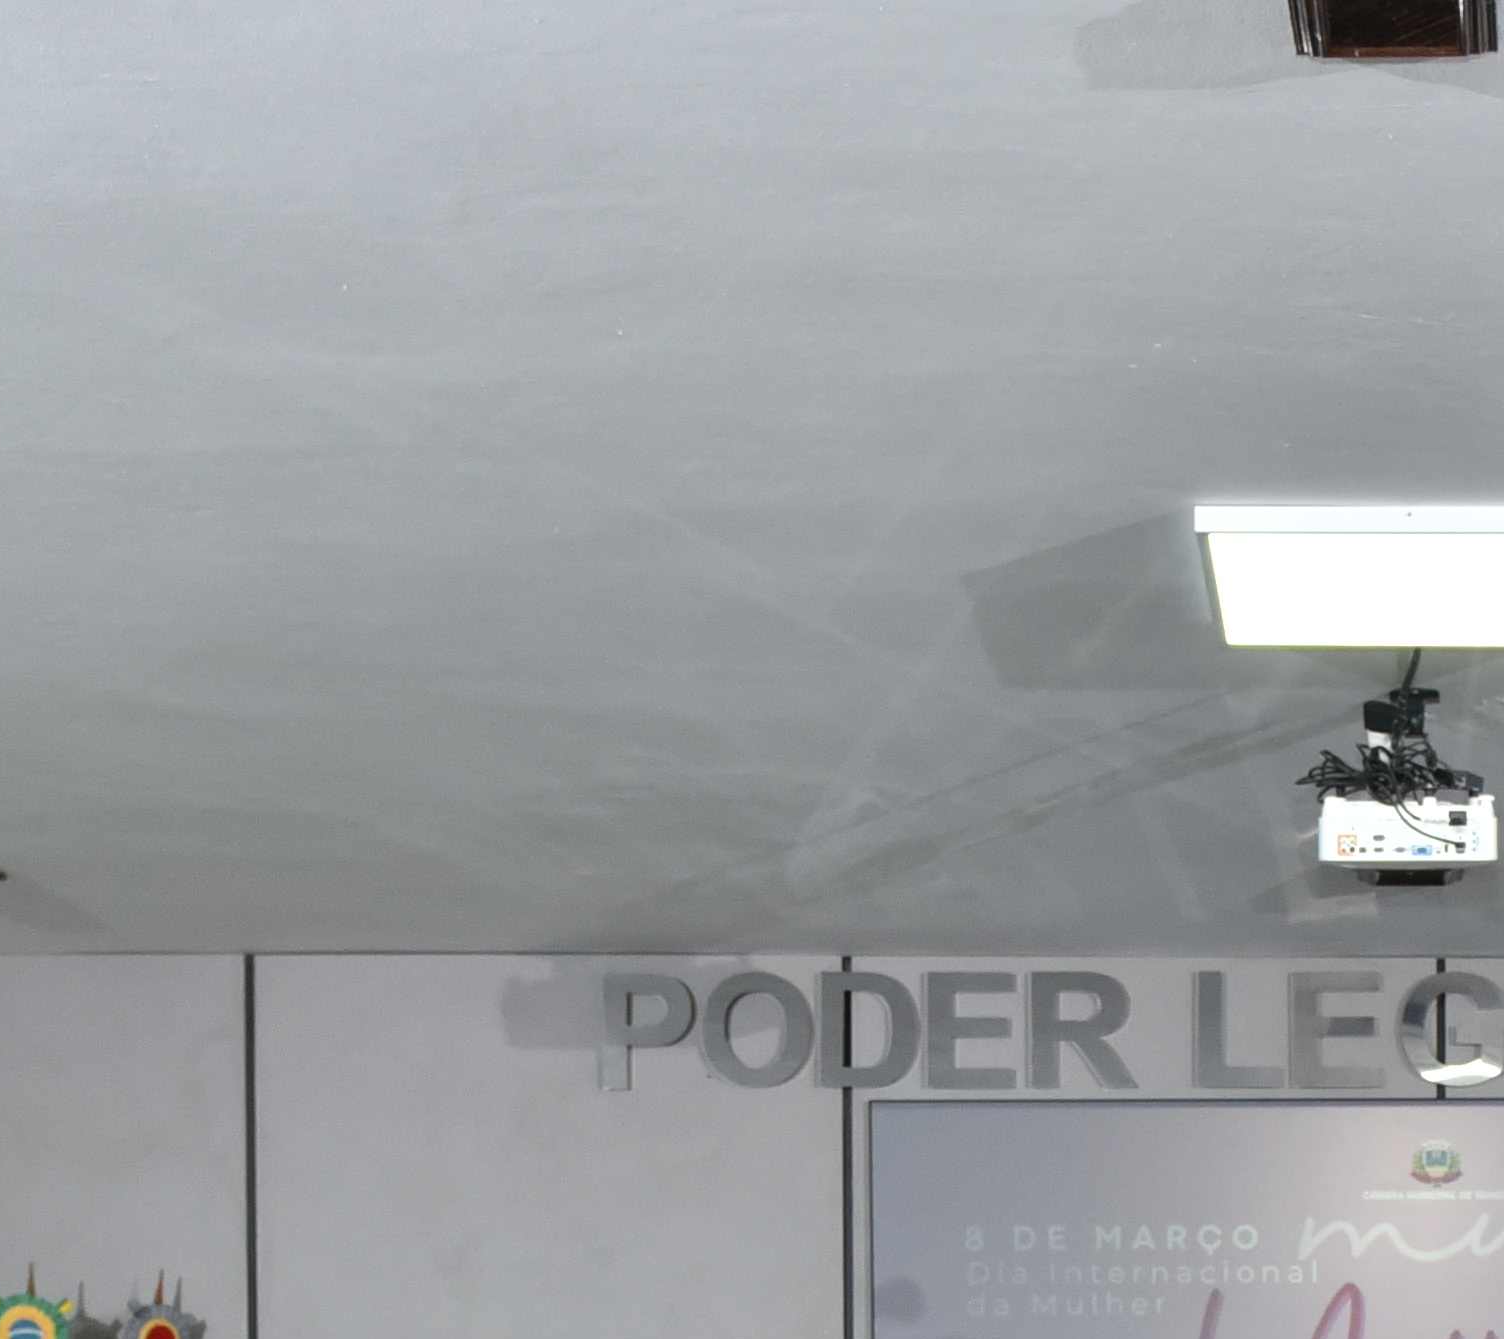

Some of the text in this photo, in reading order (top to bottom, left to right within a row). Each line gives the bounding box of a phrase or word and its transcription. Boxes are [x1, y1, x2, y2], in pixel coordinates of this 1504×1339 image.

[599, 970, 1137, 1091] PODER
[966, 1225, 1260, 1256] 8 DE MARÇO
[967, 1262, 1319, 1286] Dia Internacional
[967, 1292, 1167, 1316] da Mulher
